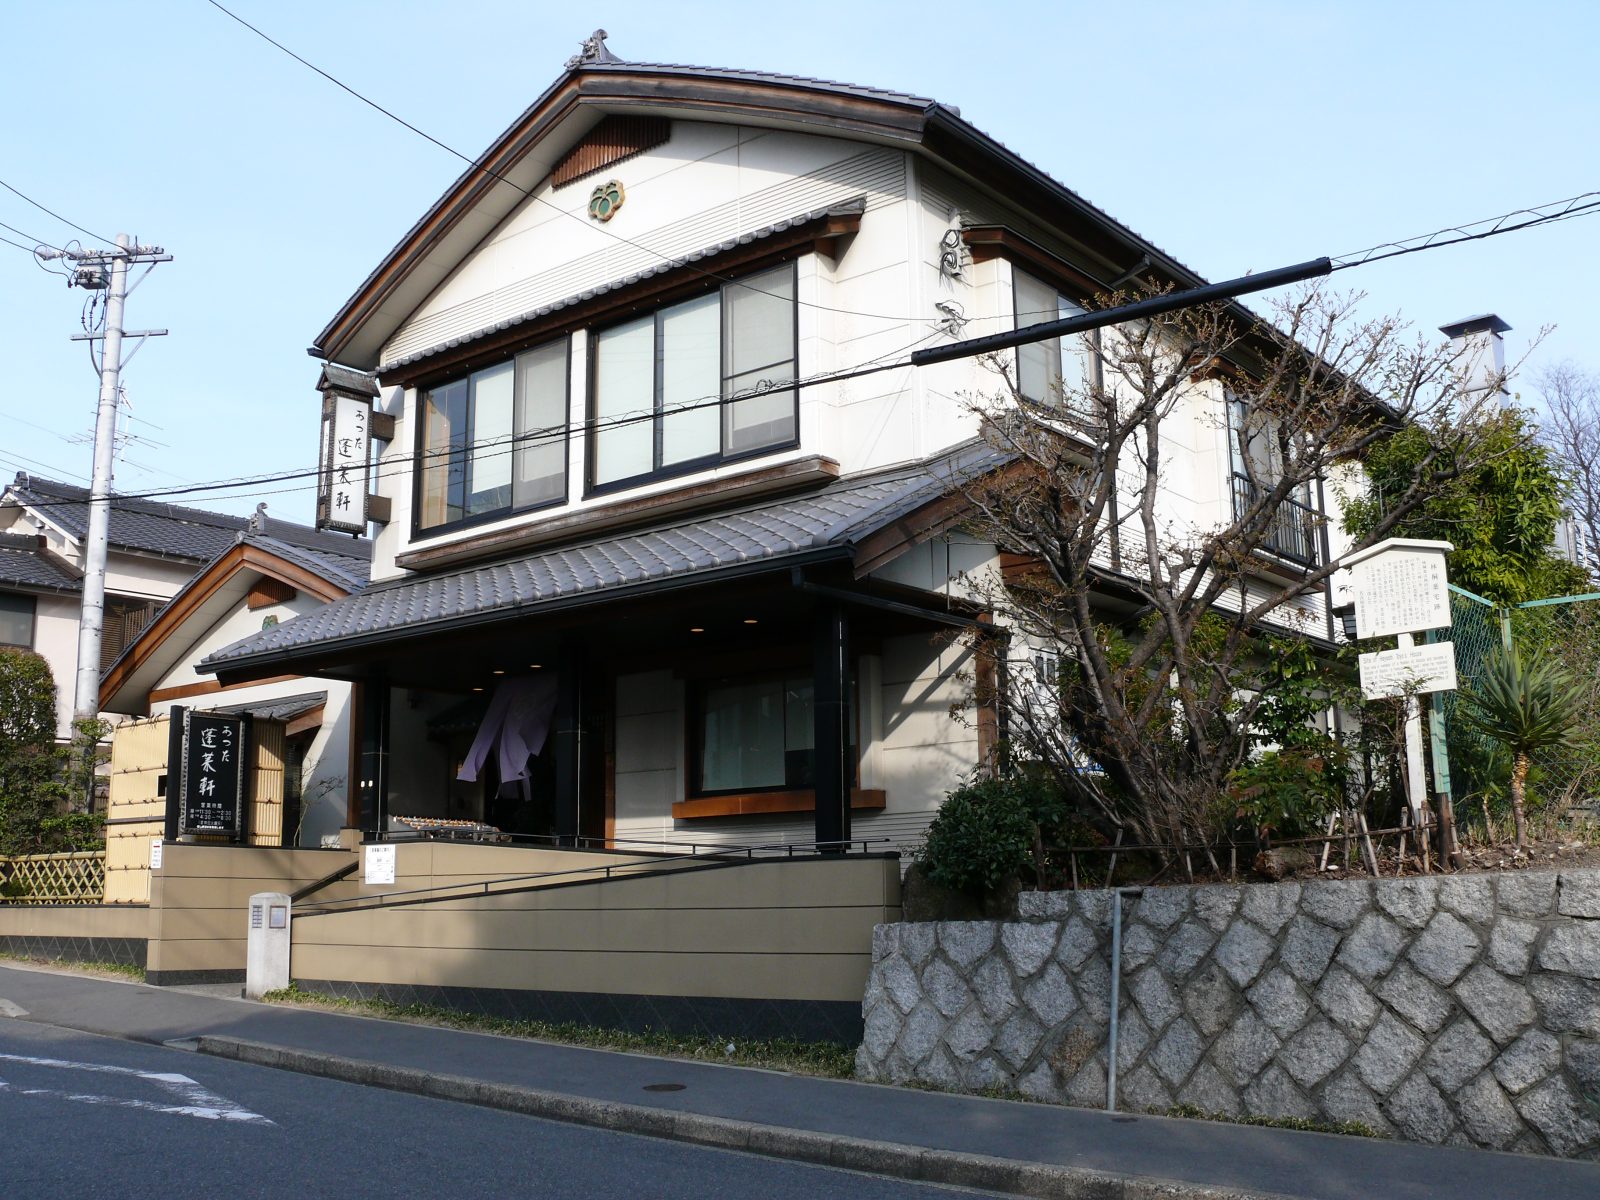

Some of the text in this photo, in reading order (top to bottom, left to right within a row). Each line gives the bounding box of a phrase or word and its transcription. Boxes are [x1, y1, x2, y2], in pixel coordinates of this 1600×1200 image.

[199, 727, 217, 797] 蓬莱軒
[221, 725, 232, 763] あつた
